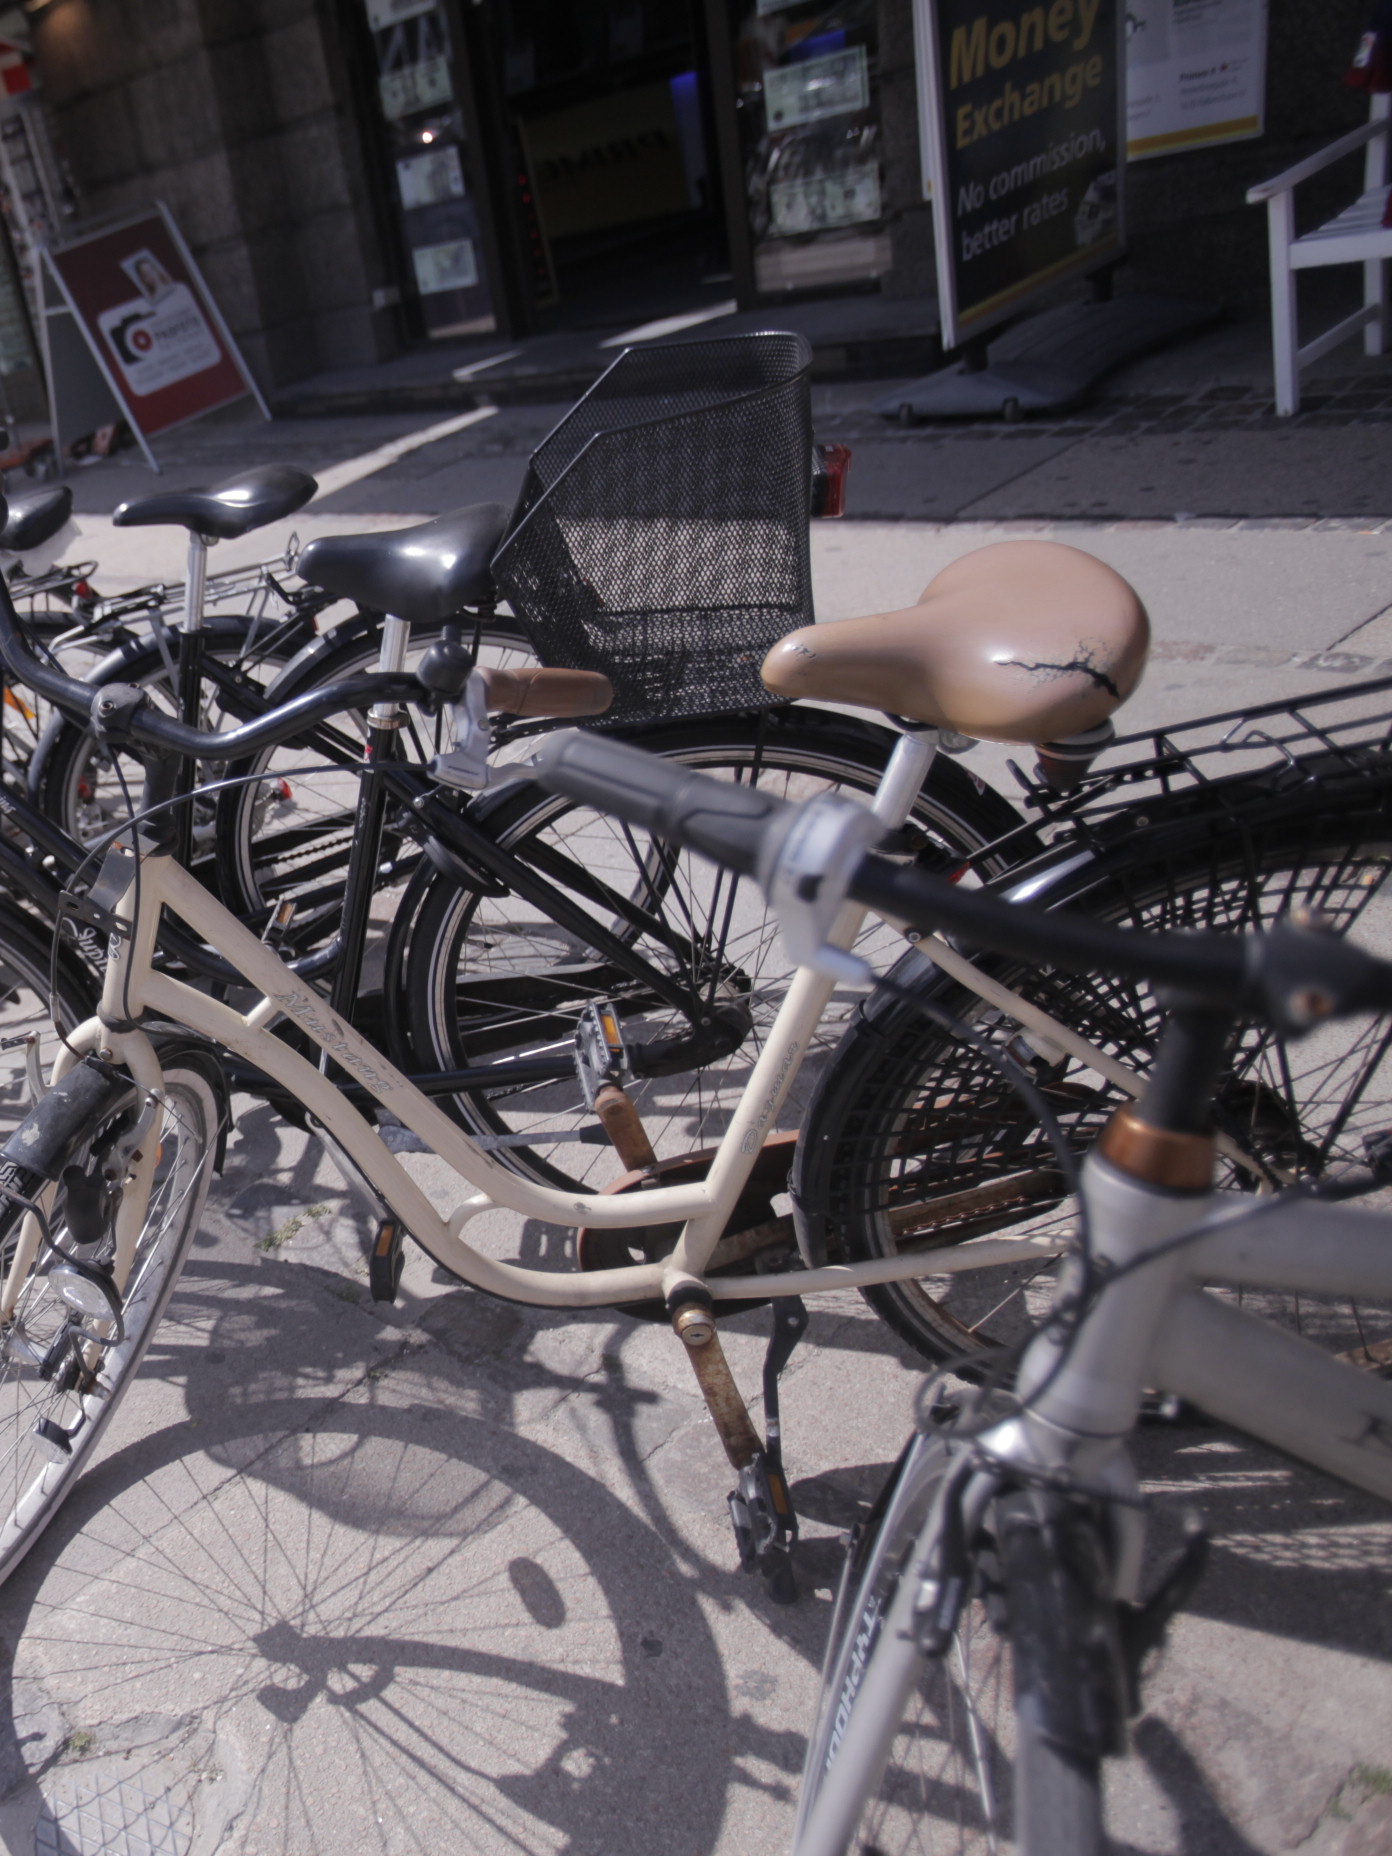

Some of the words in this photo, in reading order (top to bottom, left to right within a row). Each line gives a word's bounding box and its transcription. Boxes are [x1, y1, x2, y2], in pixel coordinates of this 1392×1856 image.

[949, 0, 1101, 90] Money
[955, 54, 1104, 151] Exchange
[957, 184, 985, 217] No
[989, 127, 1106, 202] commission,
[961, 212, 1017, 263] better
[1023, 186, 1070, 228] rates
[274, 991, 393, 1094] Mustang
[826, 1610, 879, 1771] TYPHOO
